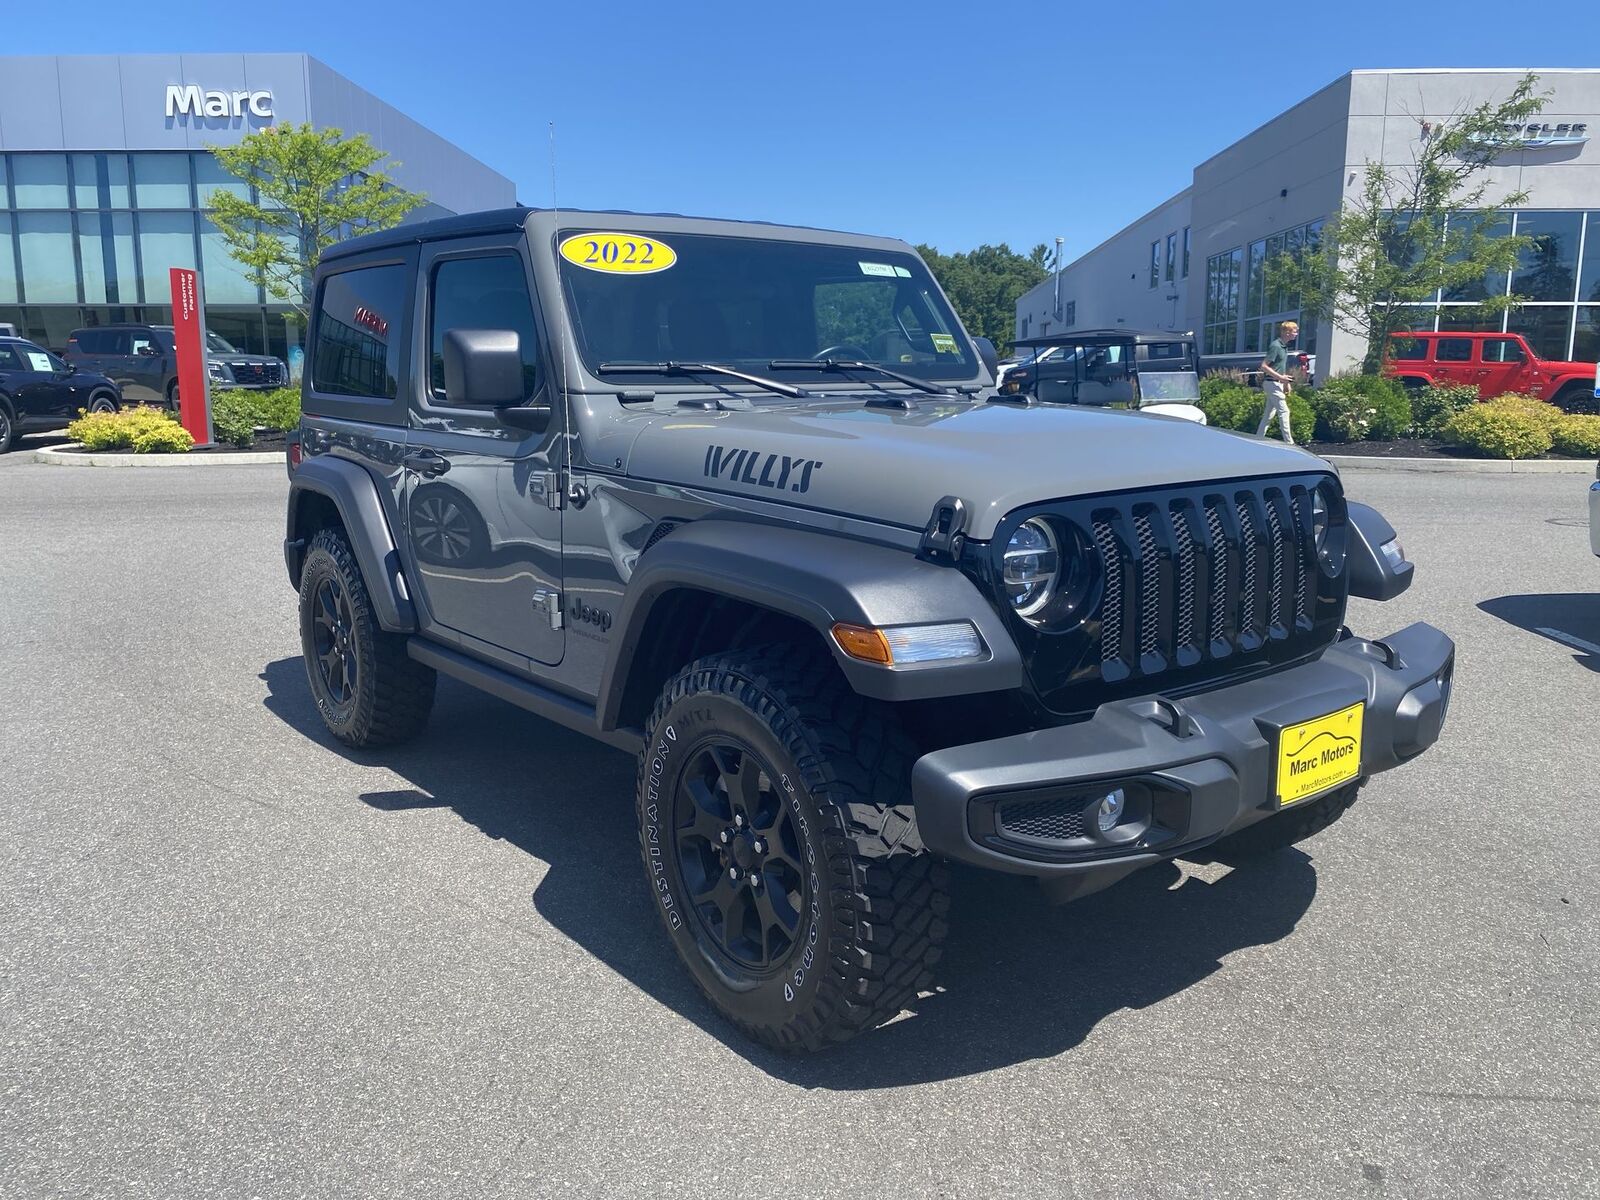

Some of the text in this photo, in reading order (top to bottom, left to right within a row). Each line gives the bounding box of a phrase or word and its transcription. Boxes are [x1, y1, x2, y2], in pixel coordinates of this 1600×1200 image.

[165, 85, 272, 117] Marc
[1488, 123, 1588, 133] RYSLER
[583, 240, 654, 264] 2022
[181, 272, 189, 320] Customer
[704, 445, 823, 493] WILLYS
[571, 597, 611, 632] Jeep
[1290, 743, 1354, 776] Marc Motors
[1301, 770, 1344, 792] MarcMotors.com
[648, 739, 681, 931] DESTINATION
[782, 773, 820, 987] Firestone
